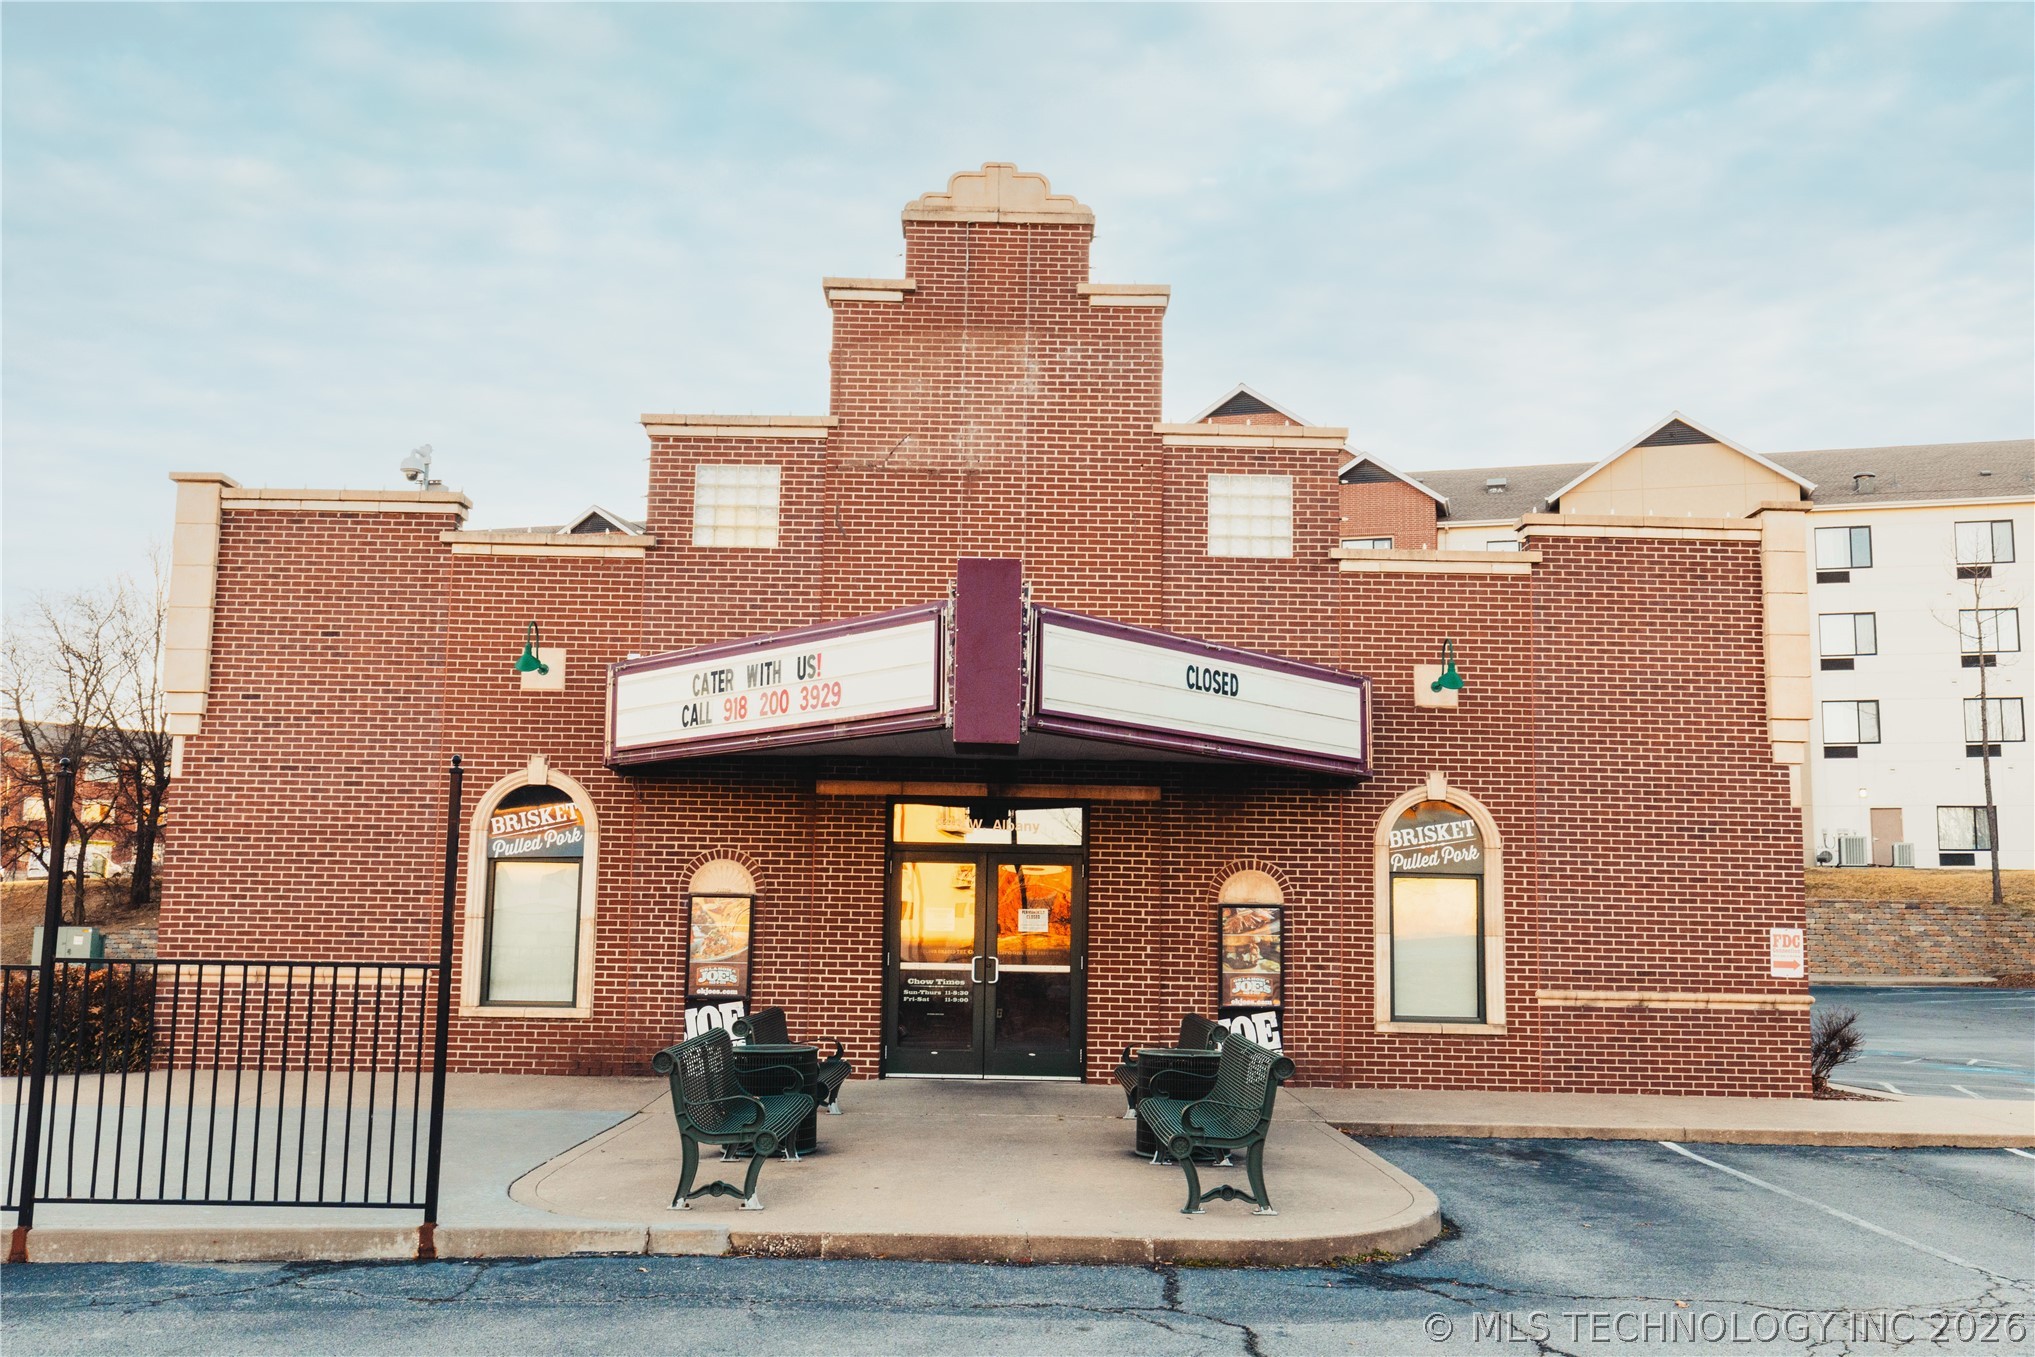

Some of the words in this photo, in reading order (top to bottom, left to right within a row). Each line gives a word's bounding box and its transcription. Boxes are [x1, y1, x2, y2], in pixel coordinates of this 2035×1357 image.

[692, 668, 734, 697] CATER
[747, 659, 782, 689] WITH
[797, 652, 822, 681] US!
[1186, 664, 1239, 697] CLOSED
[681, 701, 713, 728] CALL
[723, 695, 748, 722] 918
[759, 689, 790, 717] 200
[800, 681, 842, 711] 3929
[490, 802, 579, 835] BRISKET
[993, 818, 1040, 834] Albany
[492, 834, 543, 858] Pulled
[544, 827, 583, 849] Pork
[1389, 819, 1475, 849] BRISKET
[1390, 850, 1441, 872] Pulled
[1441, 845, 1480, 865] Pork
[1772, 934, 1801, 949] FDC
[696, 987, 738, 996] okjoes.com
[1230, 998, 1273, 1007] okjoes.com
